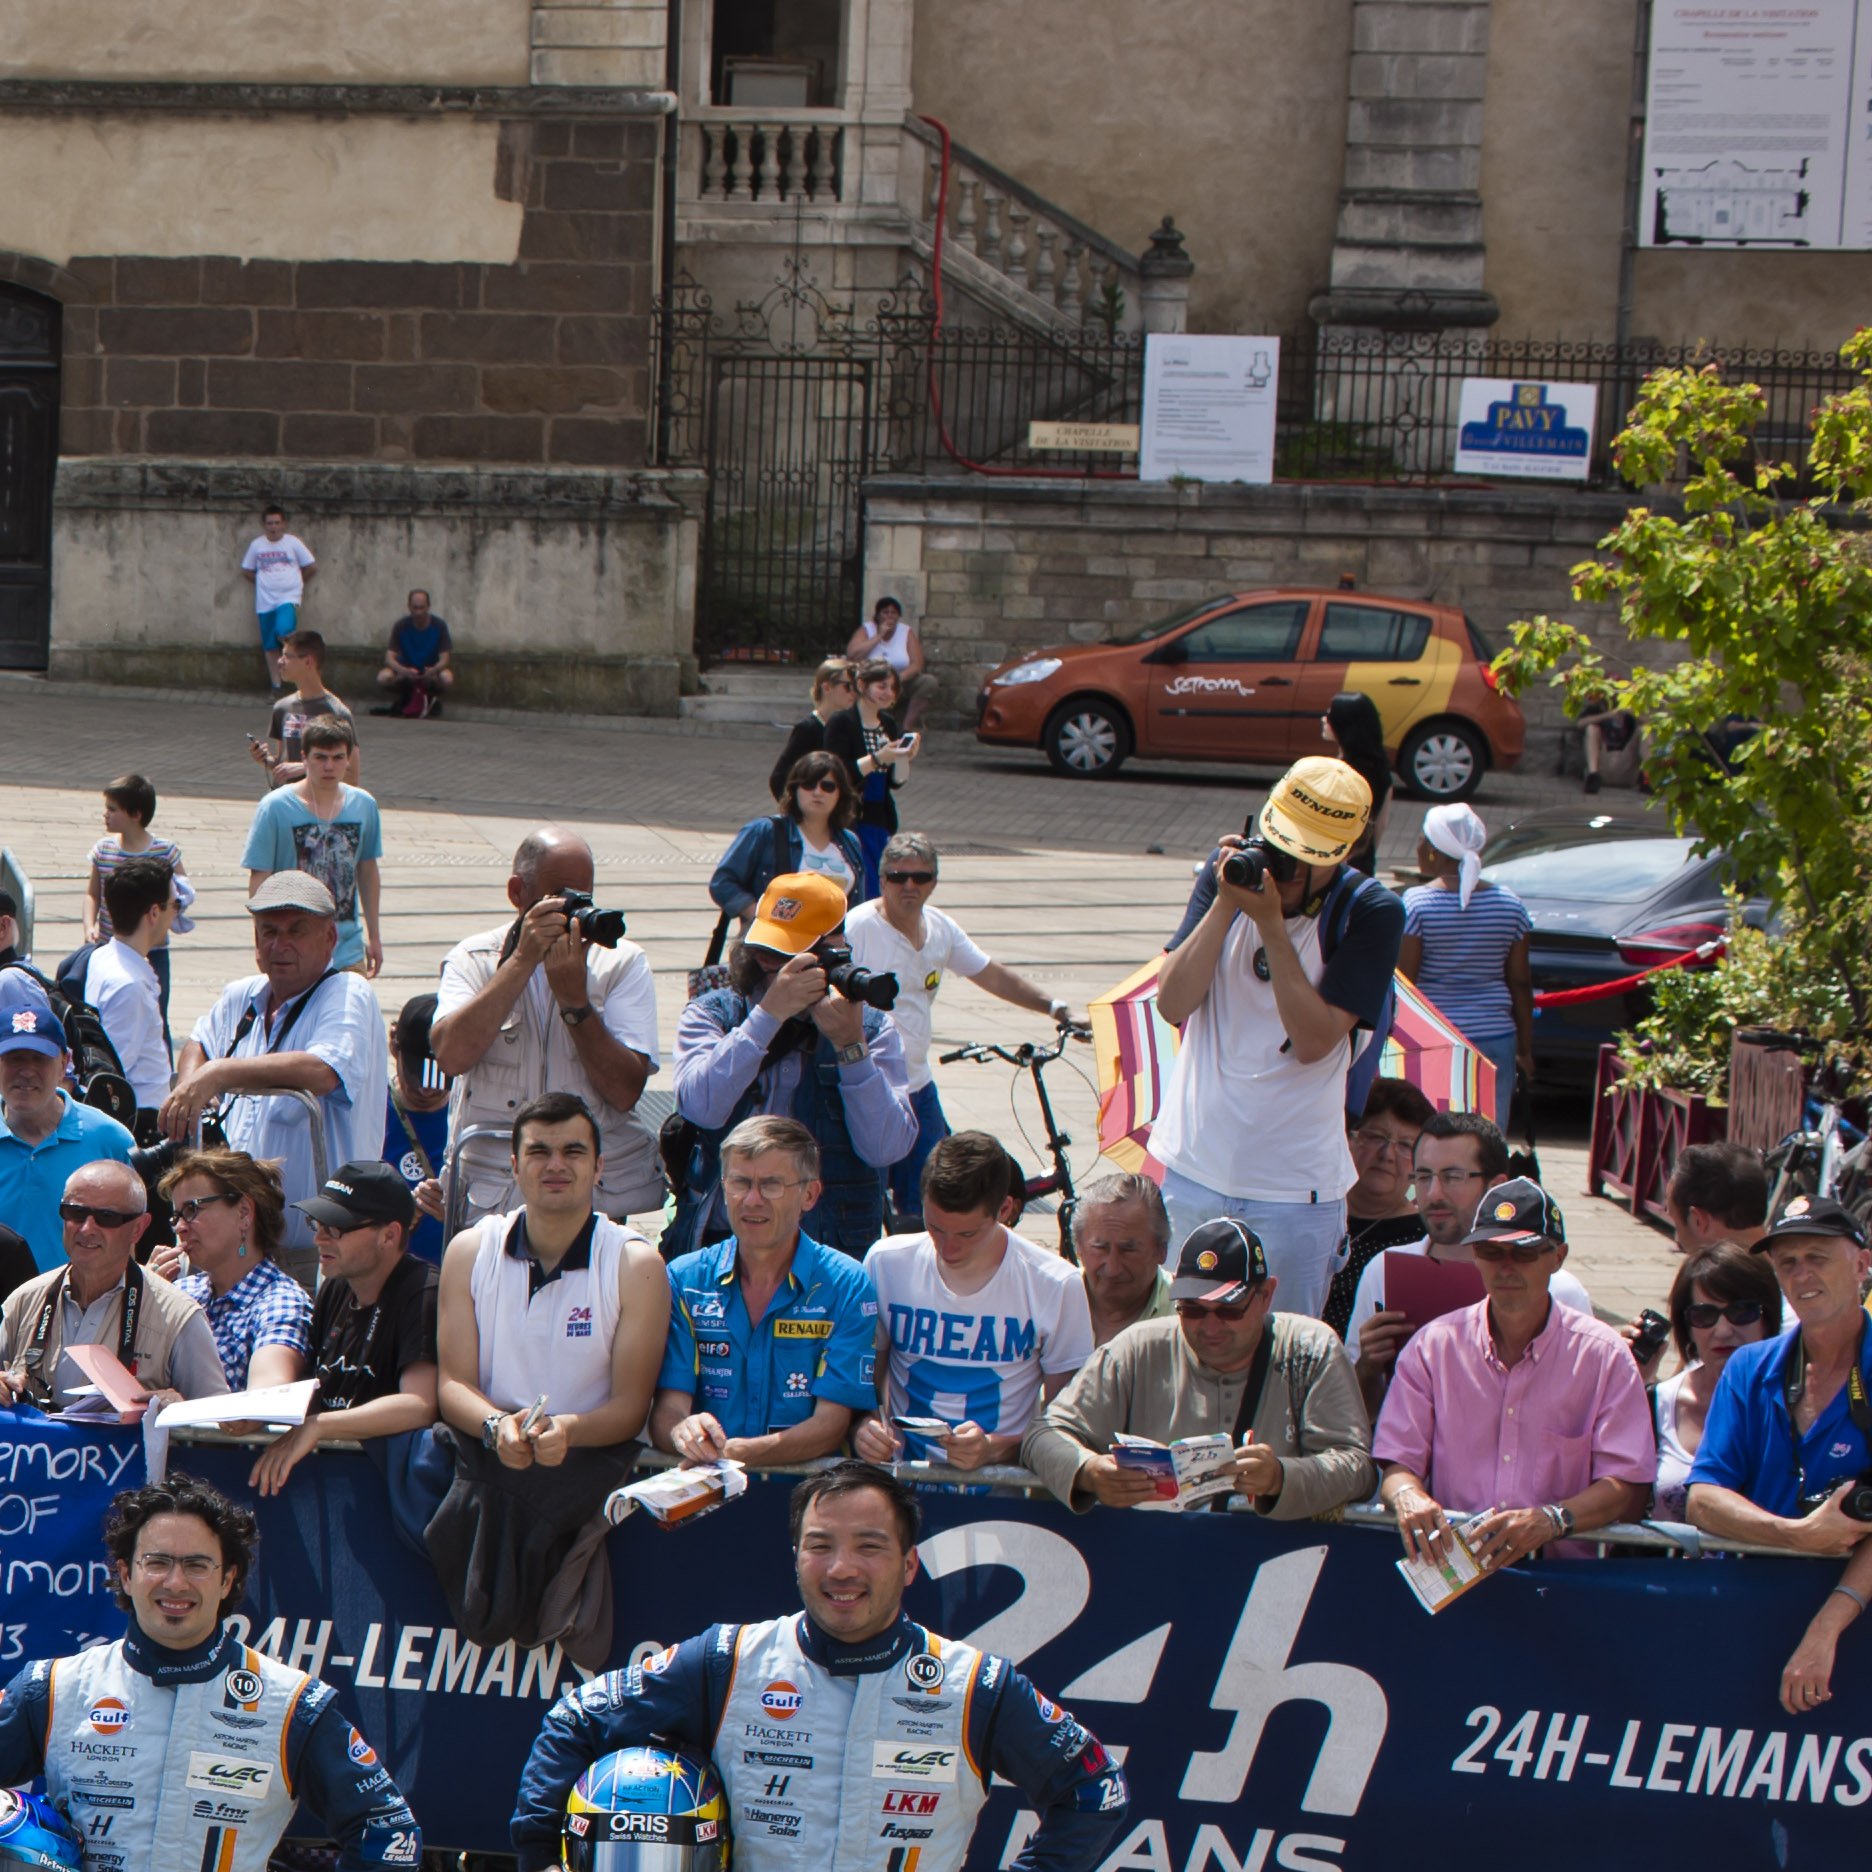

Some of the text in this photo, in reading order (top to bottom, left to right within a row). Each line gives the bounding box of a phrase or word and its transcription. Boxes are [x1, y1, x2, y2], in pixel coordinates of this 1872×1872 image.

[1495, 406, 1557, 431] PAVY
[1290, 787, 1357, 822] DUNLOP
[34, 1303, 50, 1341] Canon
[568, 1307, 592, 1322] 24
[777, 1321, 833, 1338] RENAULT
[887, 1304, 1035, 1363] DREAM
[915, 1662, 937, 1678] 10
[759, 1690, 804, 1708] Gulf
[89, 1709, 130, 1724] Gulf
[744, 1724, 813, 1744] HACKETT
[759, 1738, 795, 1748] LONDON
[70, 1740, 138, 1758] HACKETT
[86, 1754, 120, 1763] LONDON
[762, 1753, 812, 1768] MICHELIN
[893, 1750, 956, 1768] WEC
[207, 1762, 271, 1784] WEC
[88, 1795, 134, 1809] MICHELIN
[881, 1791, 940, 1815] LKM
[609, 1811, 670, 1834] ORIS
[749, 1808, 803, 1827] Hanergy
[609, 1831, 669, 1843] Swiss Watches
[696, 1822, 718, 1840] LKM
[766, 1823, 801, 1839] Solar
